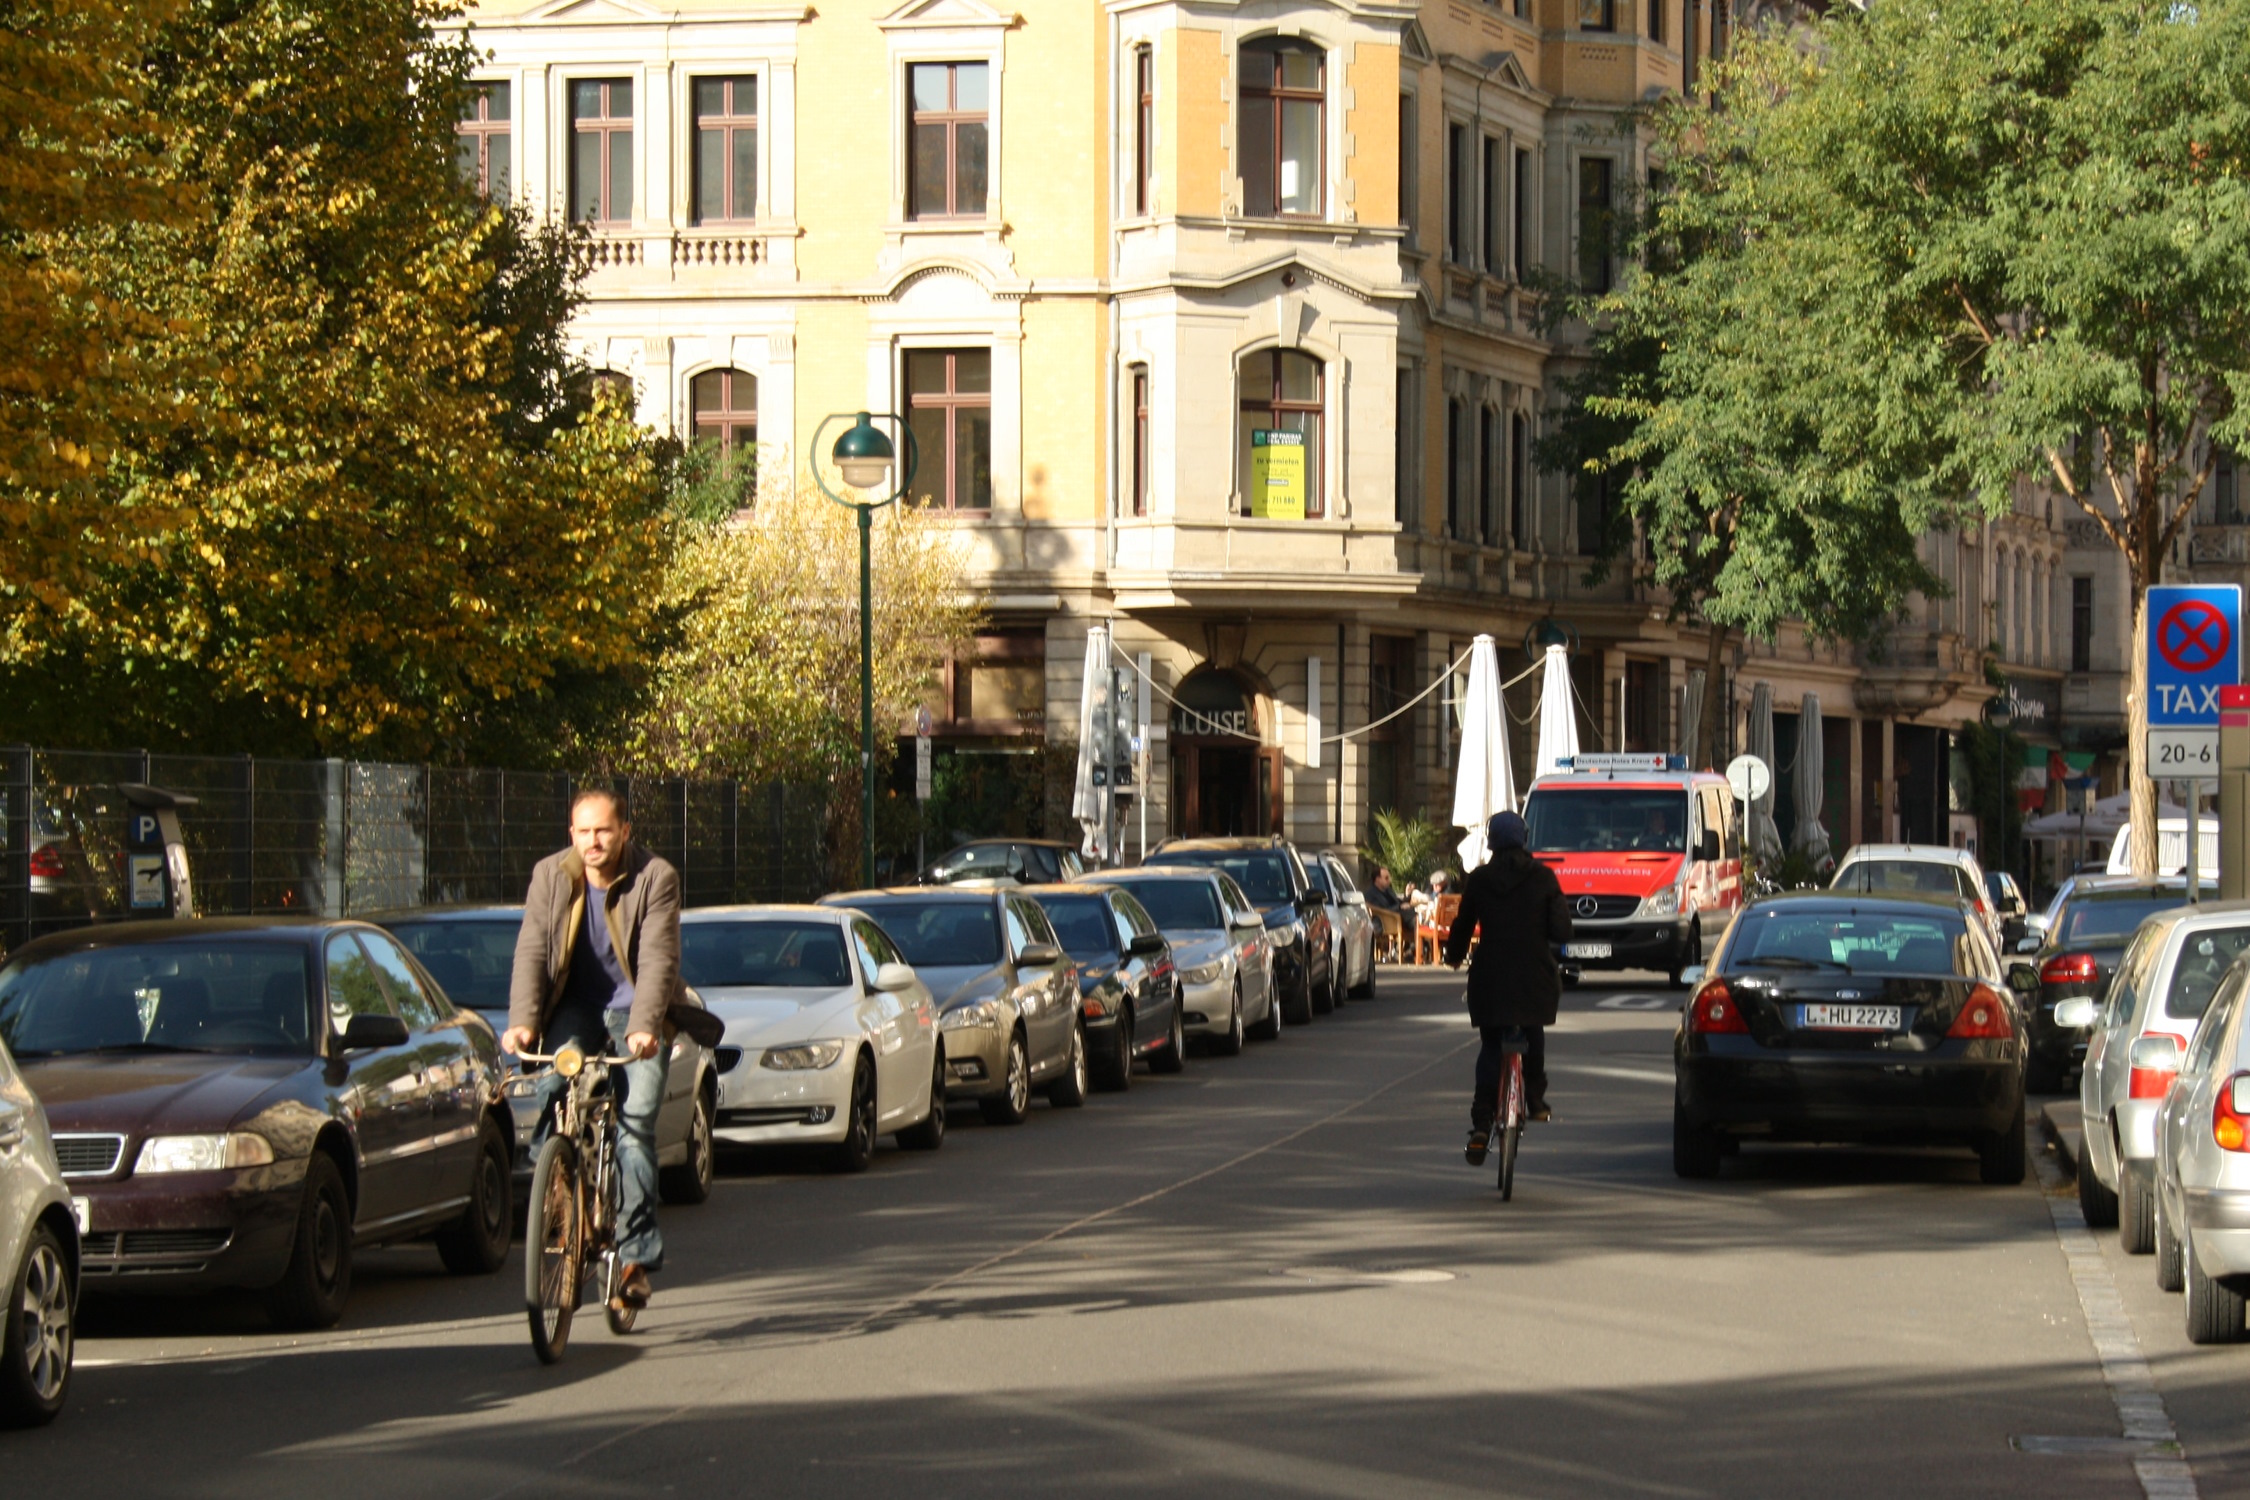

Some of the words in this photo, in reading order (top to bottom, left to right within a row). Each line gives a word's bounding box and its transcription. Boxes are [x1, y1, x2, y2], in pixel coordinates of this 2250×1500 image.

[1266, 457, 1299, 465] vermieten
[2155, 684, 2220, 714] TAX
[1181, 710, 1246, 736] LUISE
[2160, 744, 2211, 764] 20-6
[139, 816, 156, 842] P
[1554, 867, 1651, 876] ANKENWAGEN
[1829, 1007, 1852, 1024] HU
[1856, 1009, 1899, 1025] 2273
